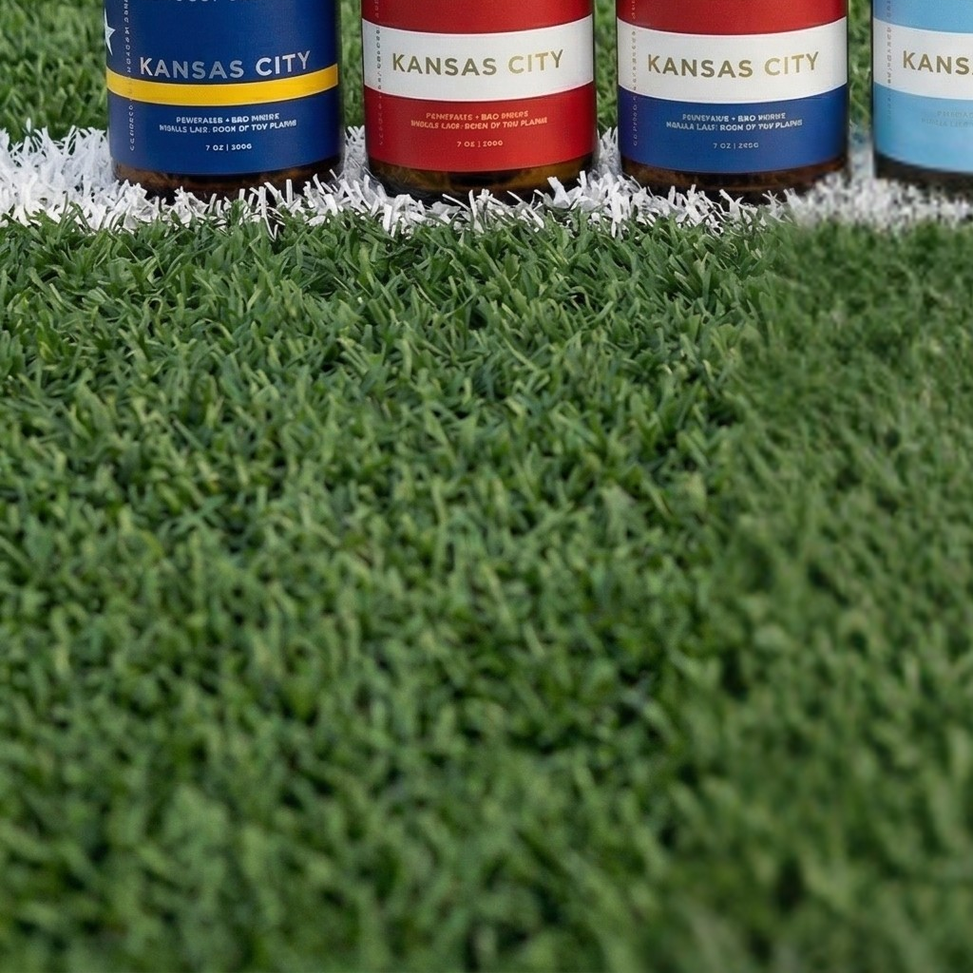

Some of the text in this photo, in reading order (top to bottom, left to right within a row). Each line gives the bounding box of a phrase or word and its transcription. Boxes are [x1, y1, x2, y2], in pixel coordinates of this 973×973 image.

[140, 51, 310, 79] KANSAS CITY
[392, 49, 564, 76] KANSAS CITY
[648, 52, 819, 77] KANSAS CITY
